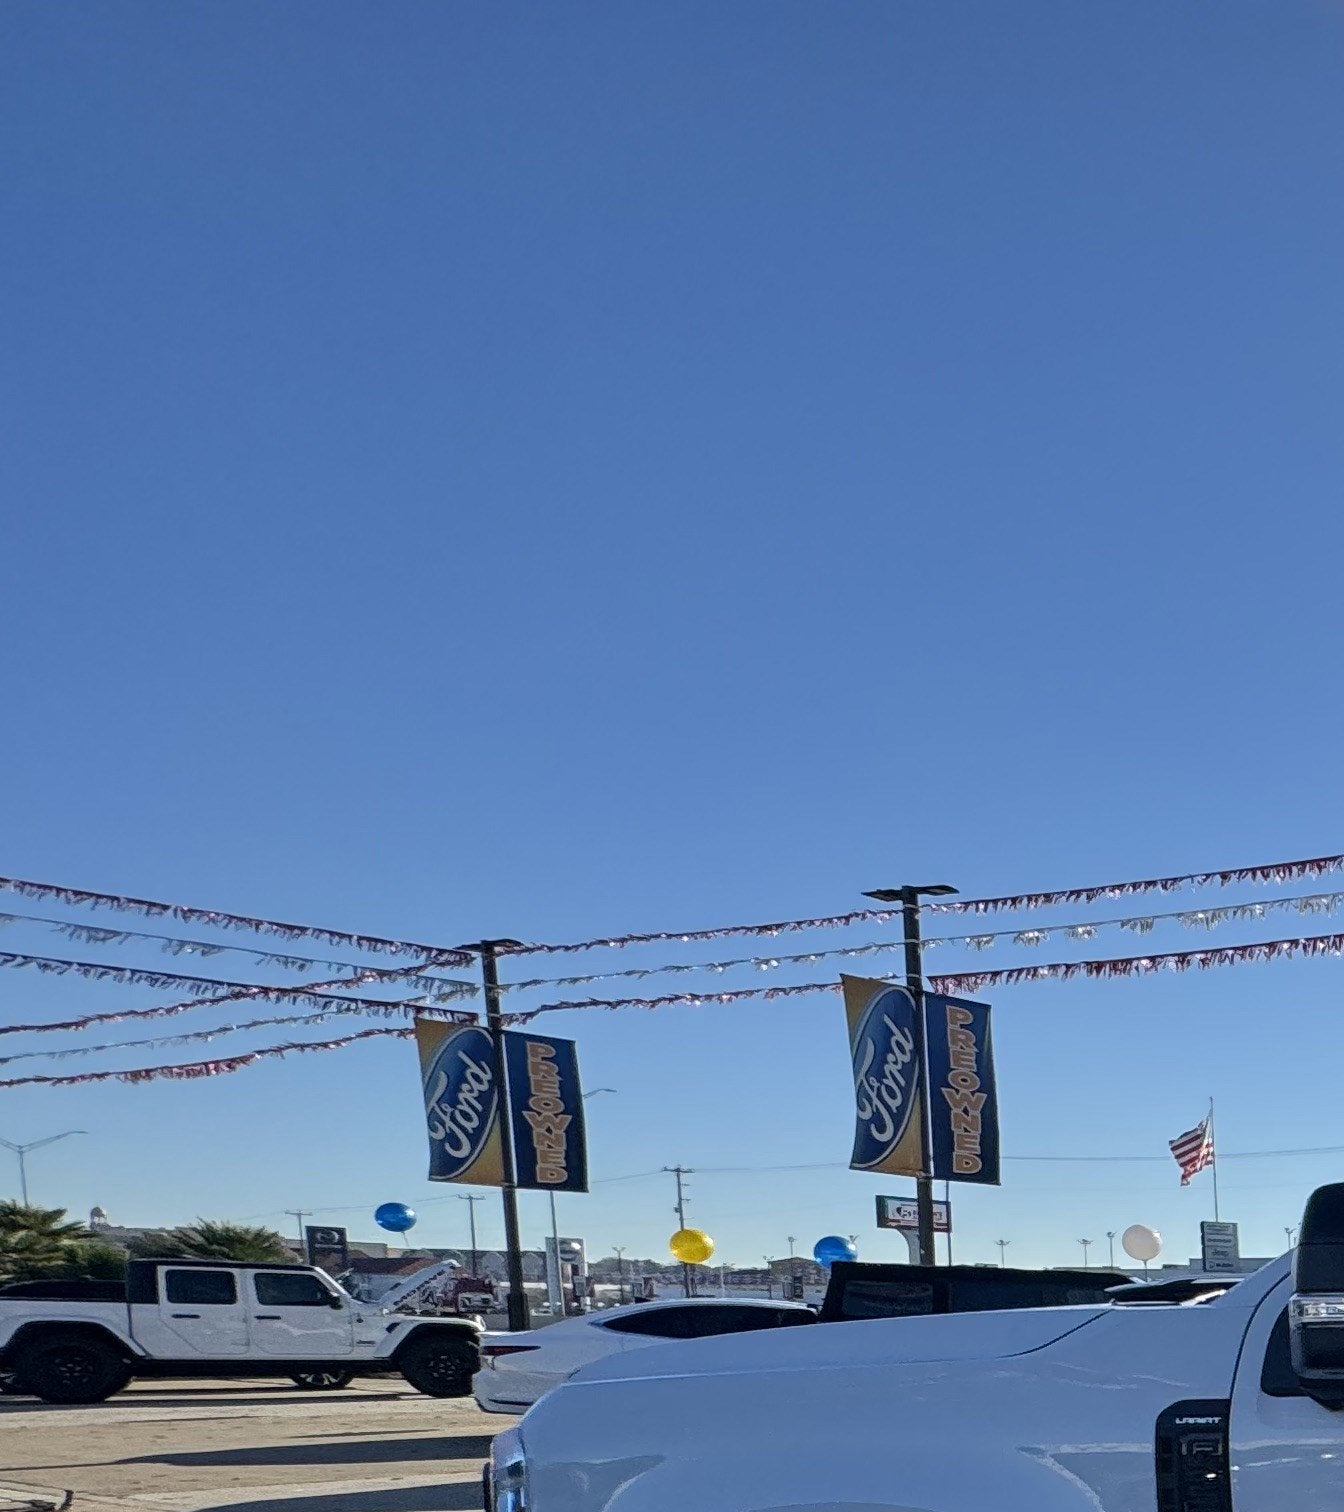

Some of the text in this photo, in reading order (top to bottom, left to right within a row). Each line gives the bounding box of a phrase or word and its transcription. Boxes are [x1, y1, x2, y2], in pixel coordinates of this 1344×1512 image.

[428, 1050, 493, 1159] Ford
[522, 1041, 573, 1184] PREOWNED
[857, 1014, 914, 1142] Ford
[941, 1004, 987, 1175] PREOWNED
